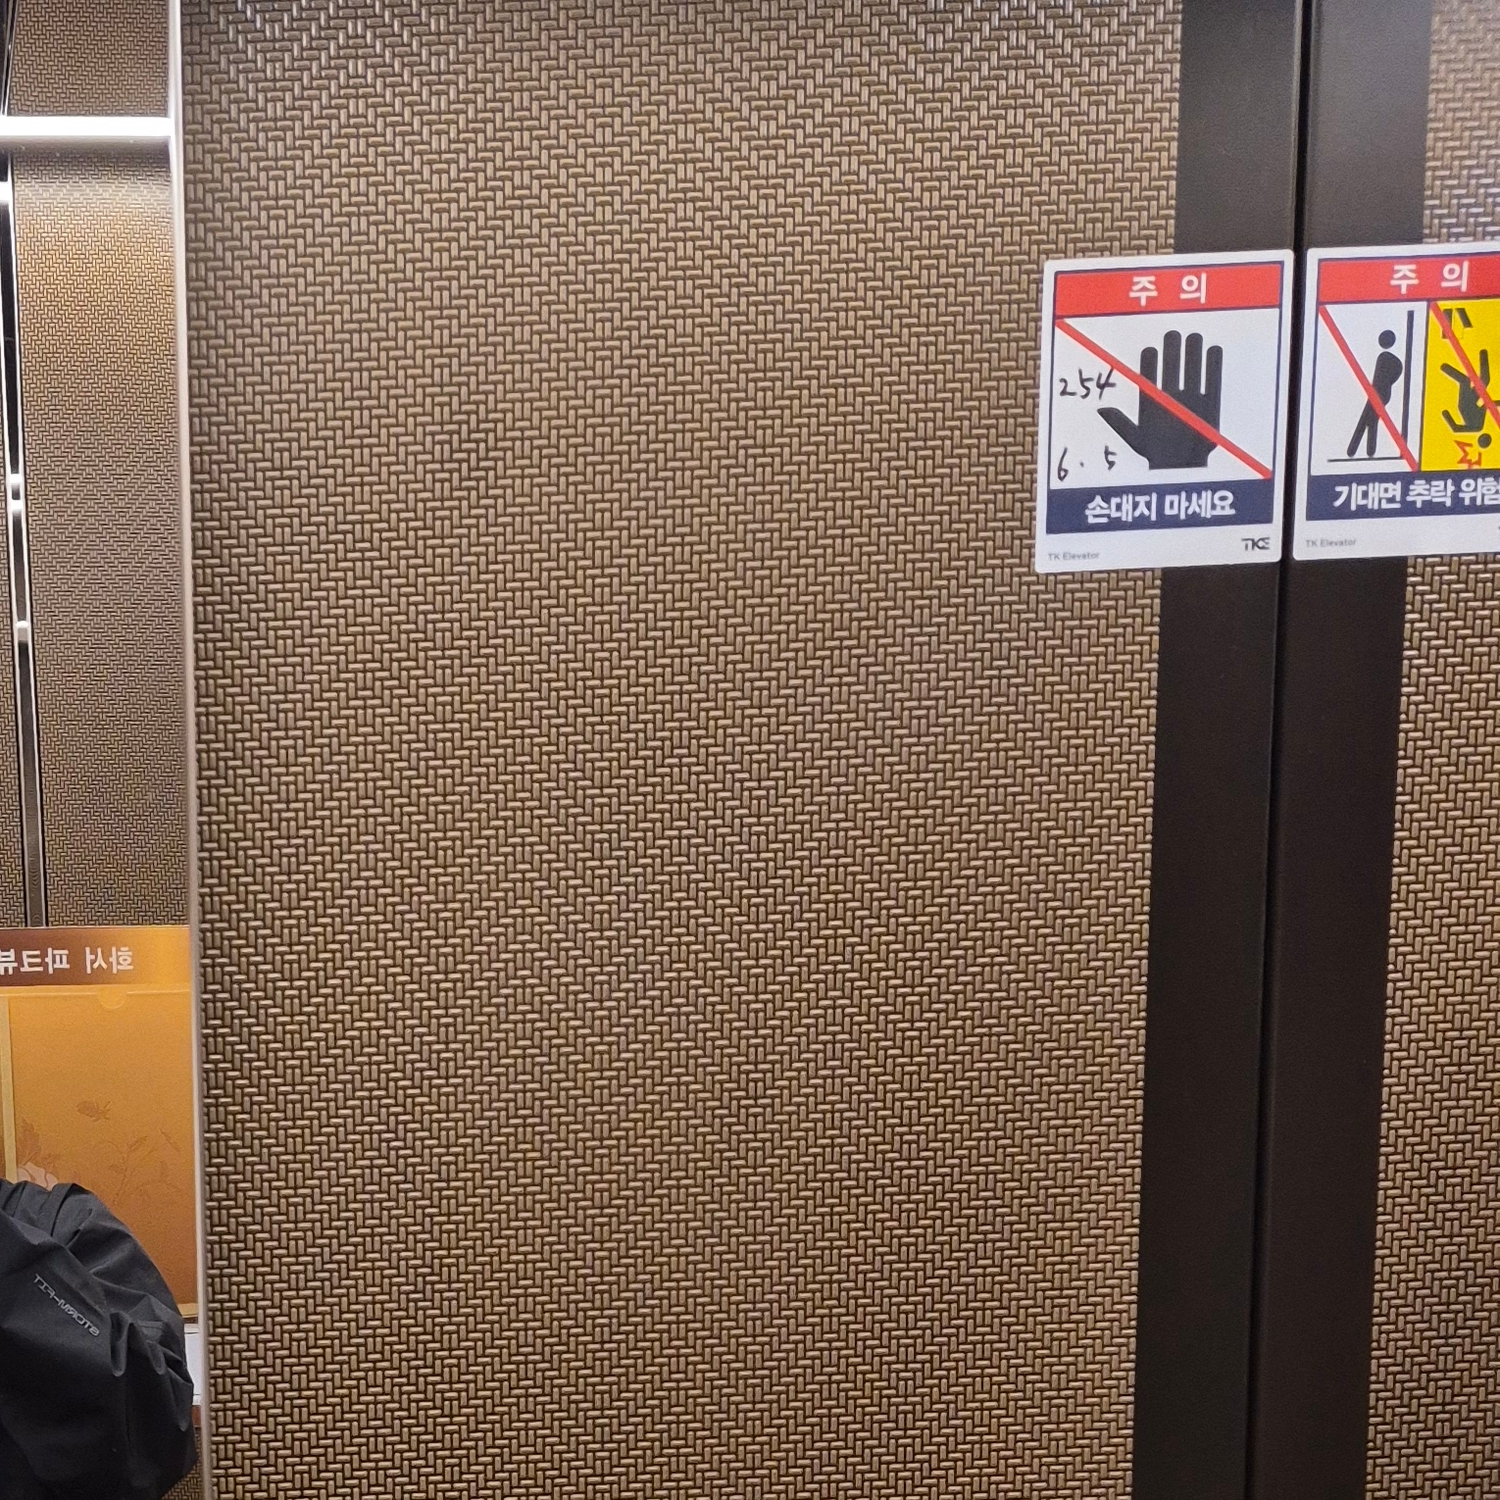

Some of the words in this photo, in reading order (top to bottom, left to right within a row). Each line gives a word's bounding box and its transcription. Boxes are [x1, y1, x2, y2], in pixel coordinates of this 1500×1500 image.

[1059, 367, 1117, 400] 254
[1084, 492, 1158, 524] 손대지
[1164, 490, 1236, 519] 마세요
[1333, 480, 1402, 511] 기대면
[1406, 477, 1454, 508] 추락
[1047, 552, 1060, 562] TK
[1062, 549, 1100, 562] Elevator
[1305, 538, 1319, 548] TK
[1320, 534, 1358, 548] Elevator
